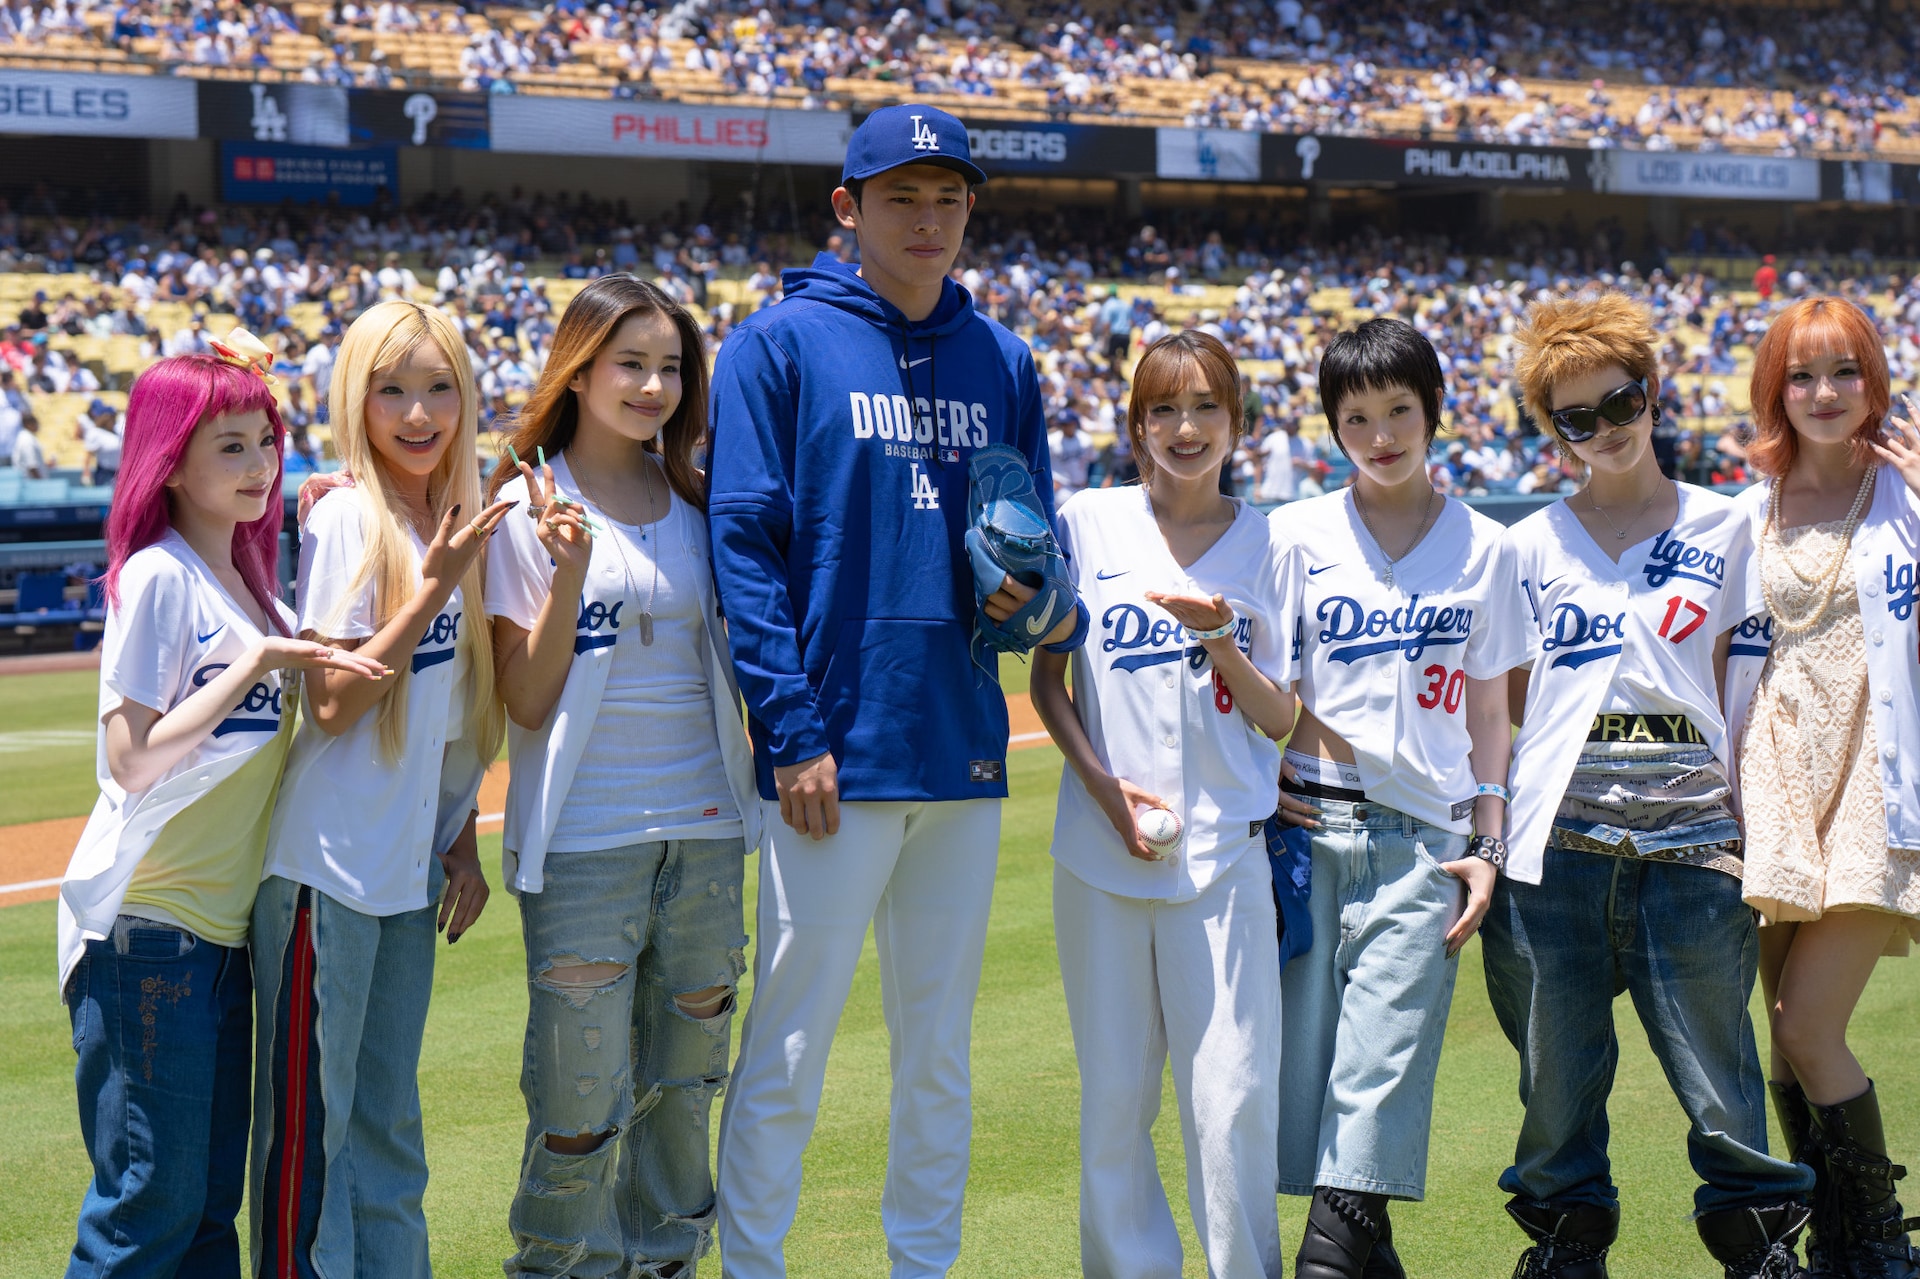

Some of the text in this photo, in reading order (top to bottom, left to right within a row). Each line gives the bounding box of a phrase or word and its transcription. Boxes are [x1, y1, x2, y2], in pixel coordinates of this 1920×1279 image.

[612, 113, 769, 147] PHILLIES
[910, 115, 940, 150] LA
[1404, 147, 1571, 182] PHILADELPHIA
[1636, 160, 1684, 184] LOS
[1689, 162, 1790, 188] ANGELES
[850, 392, 988, 449] DODGERS
[885, 443, 940, 460] BASEBAL
[910, 463, 939, 510] LA
[1316, 594, 1472, 662] Dodgers
[1658, 596, 1708, 645] 17
[1417, 664, 1465, 714] 30
